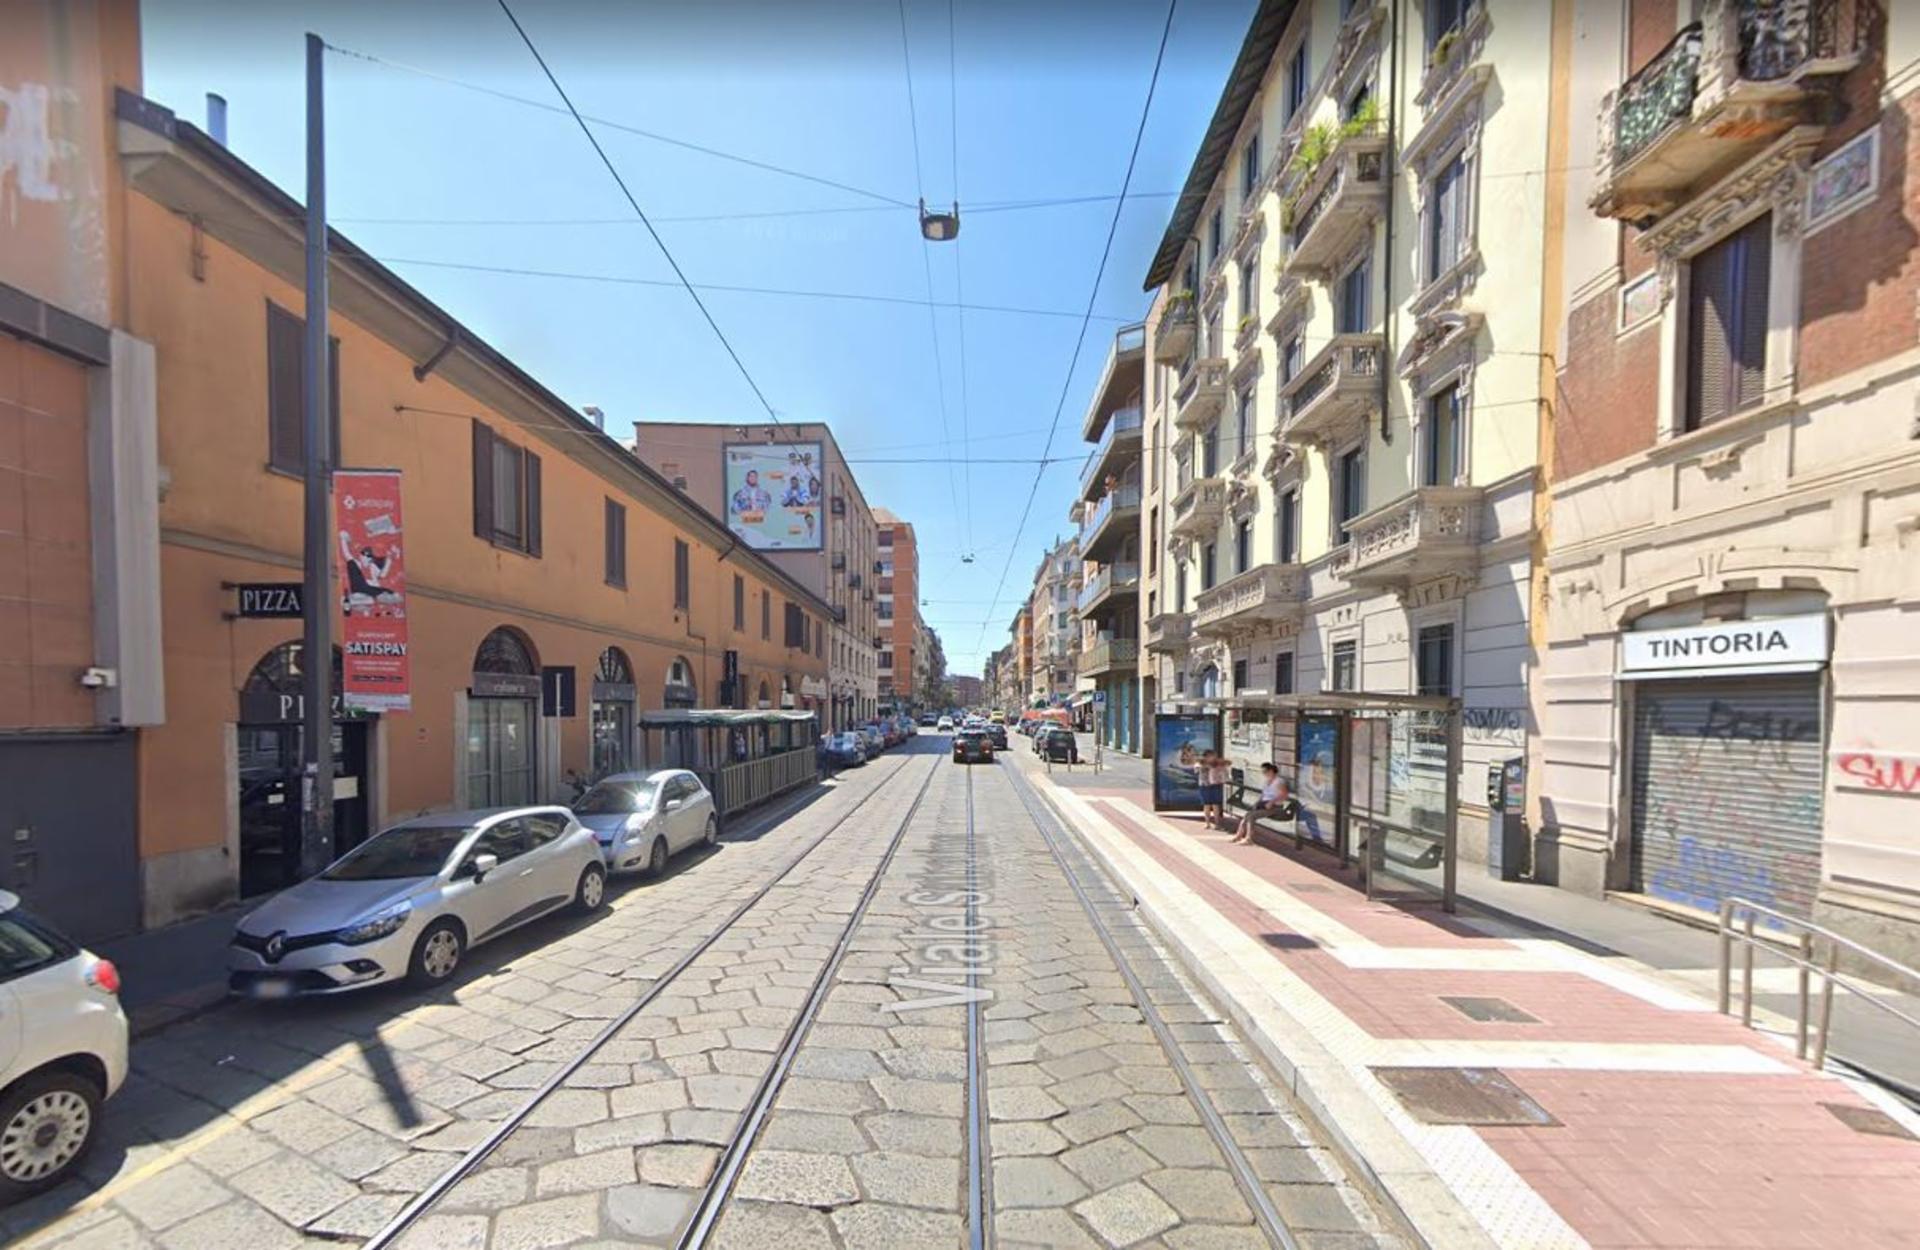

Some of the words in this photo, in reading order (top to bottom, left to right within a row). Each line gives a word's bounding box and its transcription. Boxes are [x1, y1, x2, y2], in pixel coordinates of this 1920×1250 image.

[242, 589, 301, 612] PIZZA
[345, 641, 408, 656] SATISPAY
[1647, 630, 1790, 659] TINTORIA
[279, 694, 357, 719] PIZ
